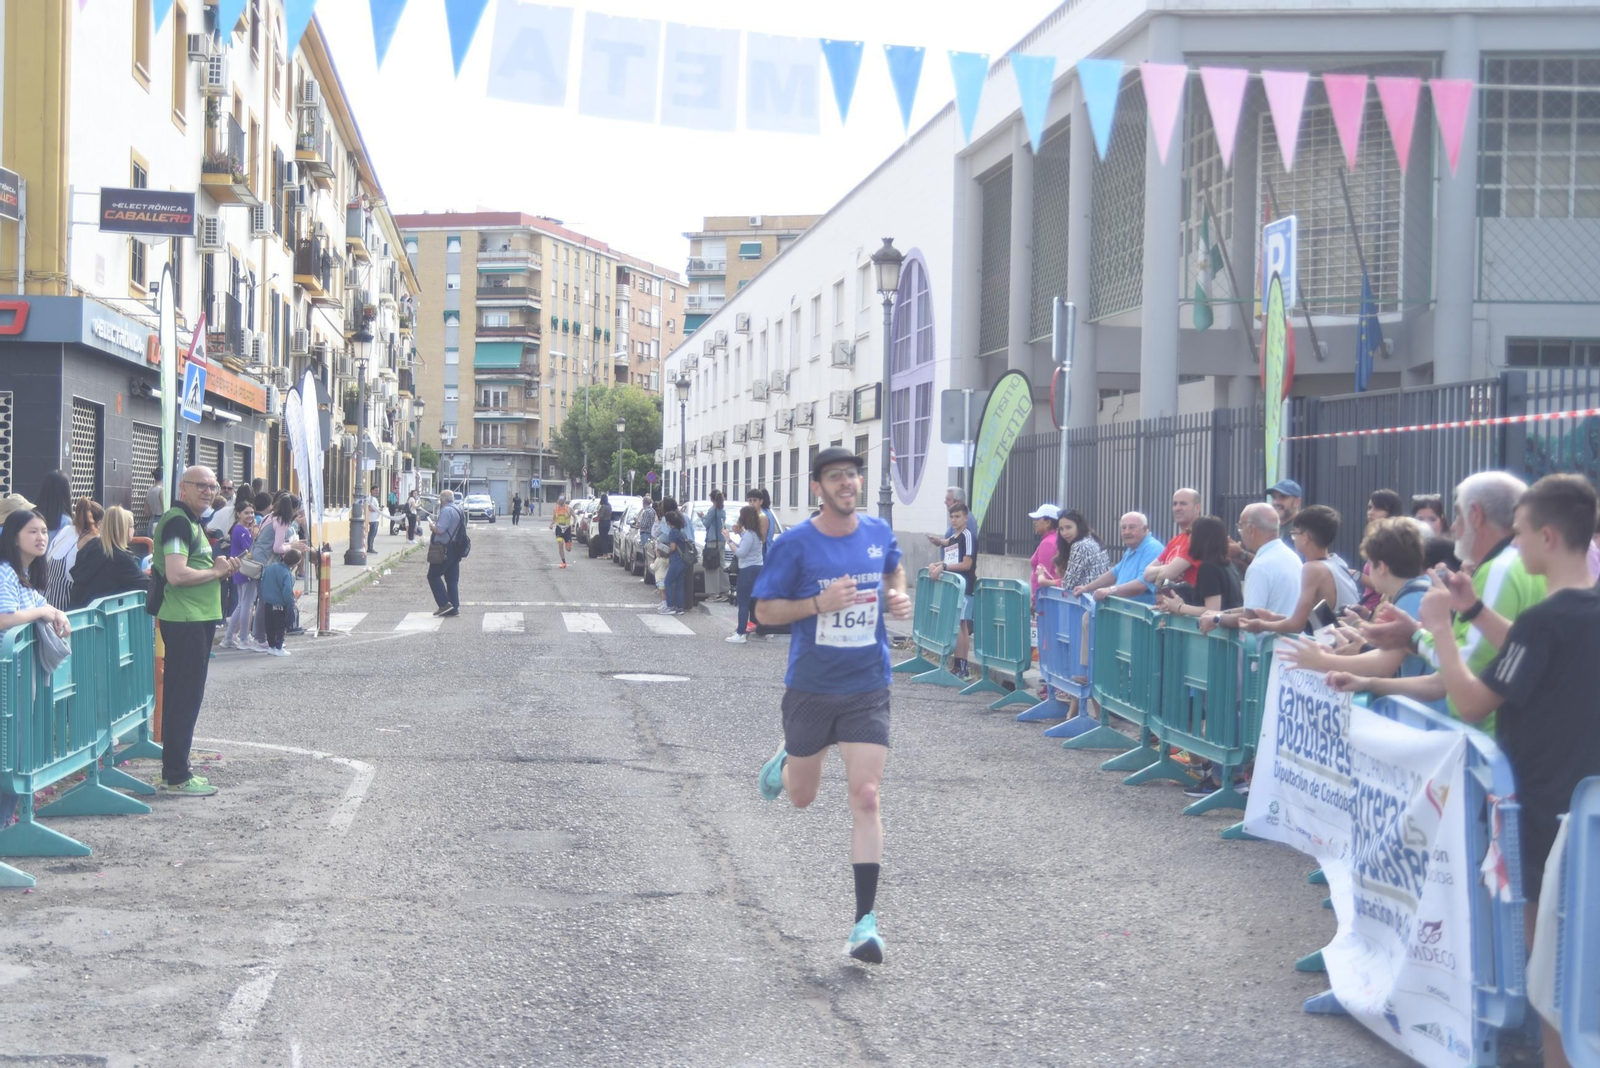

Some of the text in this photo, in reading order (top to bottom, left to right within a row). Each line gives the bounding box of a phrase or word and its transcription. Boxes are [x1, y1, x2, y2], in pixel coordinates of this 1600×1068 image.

[115, 202, 184, 212] ELECTRÓNICA
[104, 210, 192, 224] CABALLERO
[832, 610, 867, 628] 164
[1278, 684, 1341, 738] carreras
[1310, 777, 1320, 799] de
